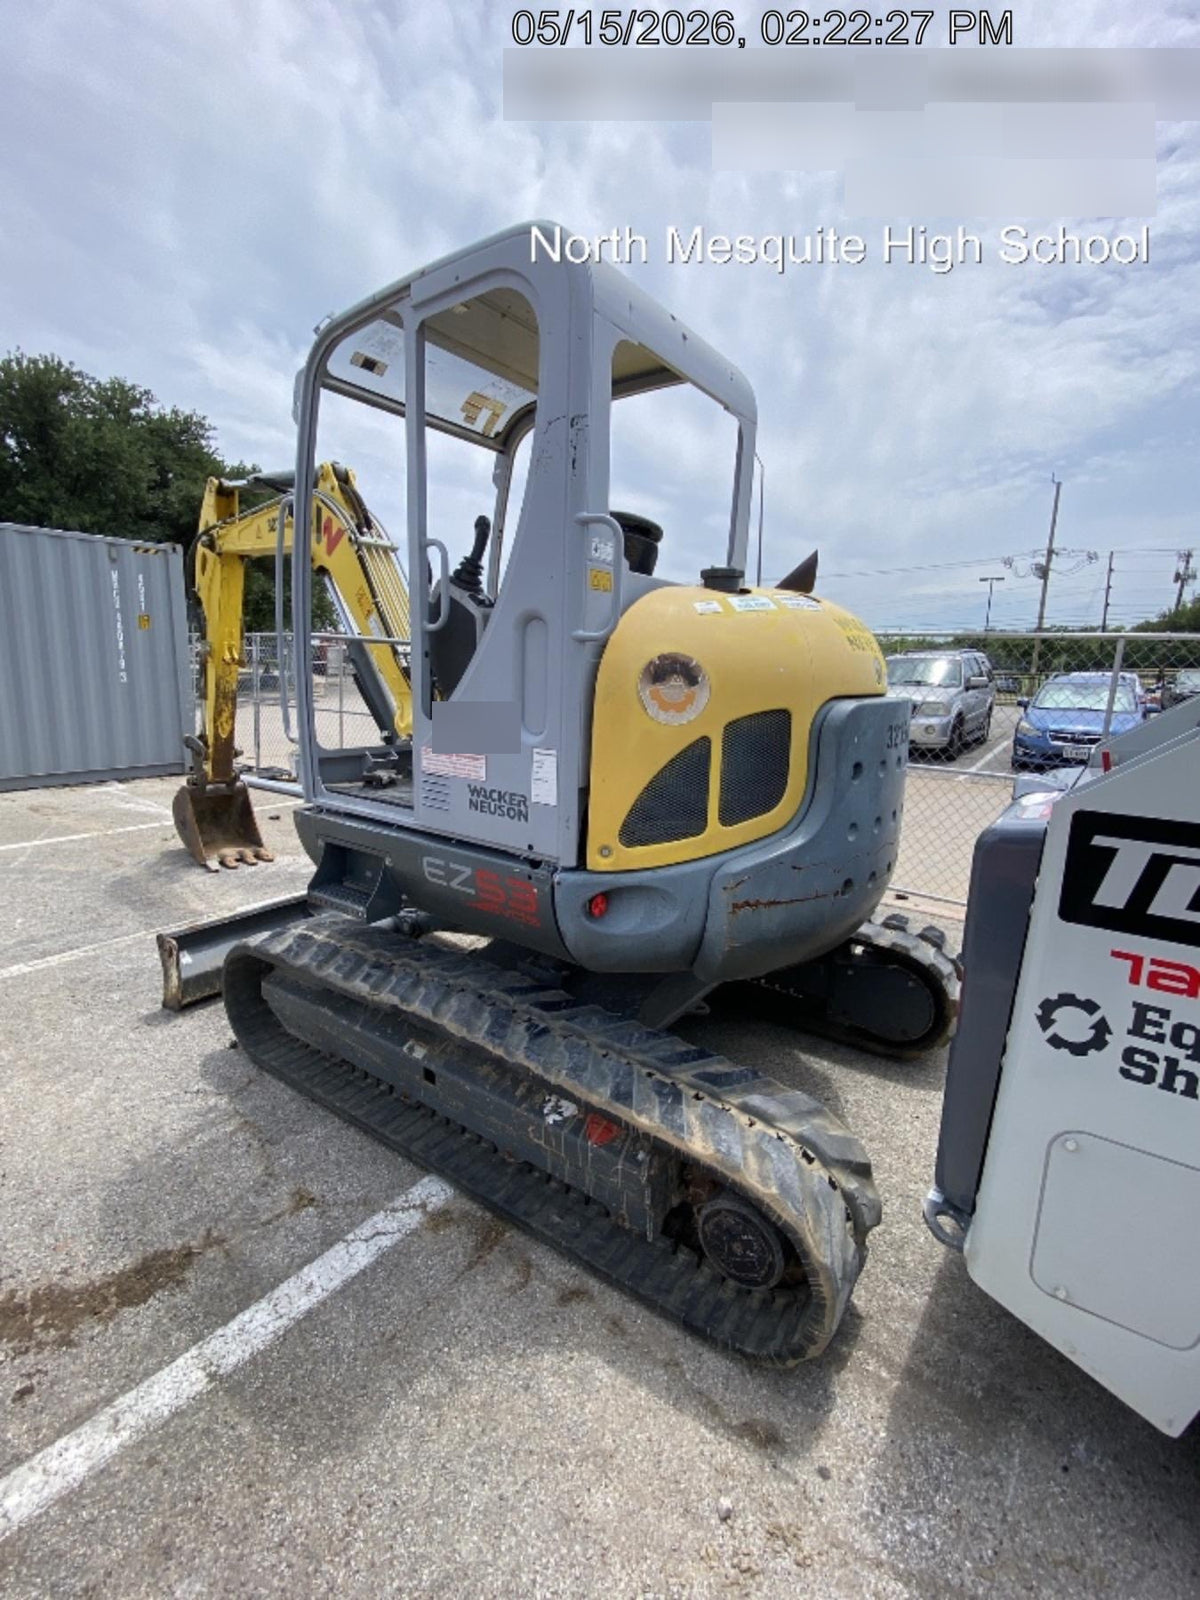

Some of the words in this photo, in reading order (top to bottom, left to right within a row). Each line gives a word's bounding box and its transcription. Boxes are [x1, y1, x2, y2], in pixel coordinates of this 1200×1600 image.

[467, 783, 528, 808] WACKER
[468, 798, 529, 822] NEUSON
[1126, 1000, 1200, 1063] Eq
[1118, 1045, 1199, 1101] Sh
